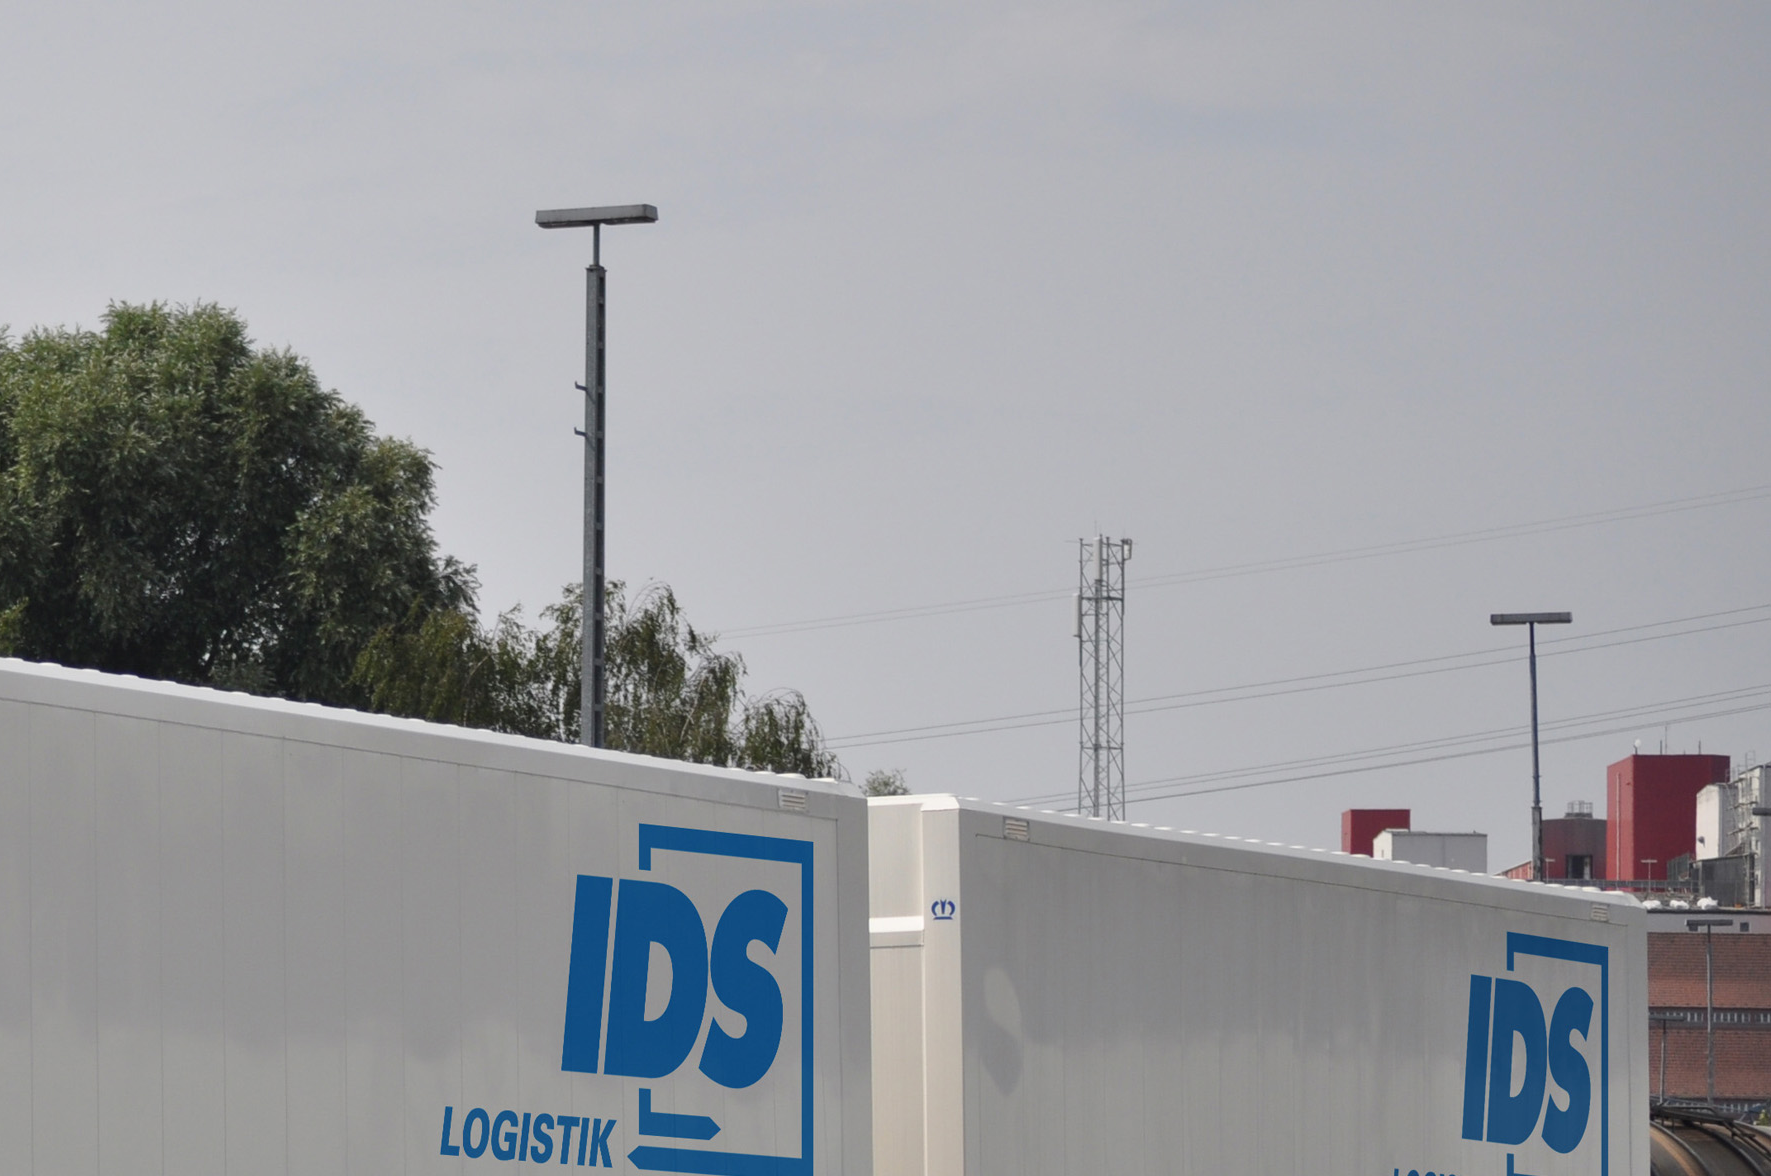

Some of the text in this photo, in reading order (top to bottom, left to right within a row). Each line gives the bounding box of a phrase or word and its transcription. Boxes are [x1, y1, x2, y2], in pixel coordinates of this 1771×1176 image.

[561, 874, 788, 1089] IDS
[1461, 974, 1594, 1154] IDS
[440, 1106, 617, 1168] LOGISTIK
